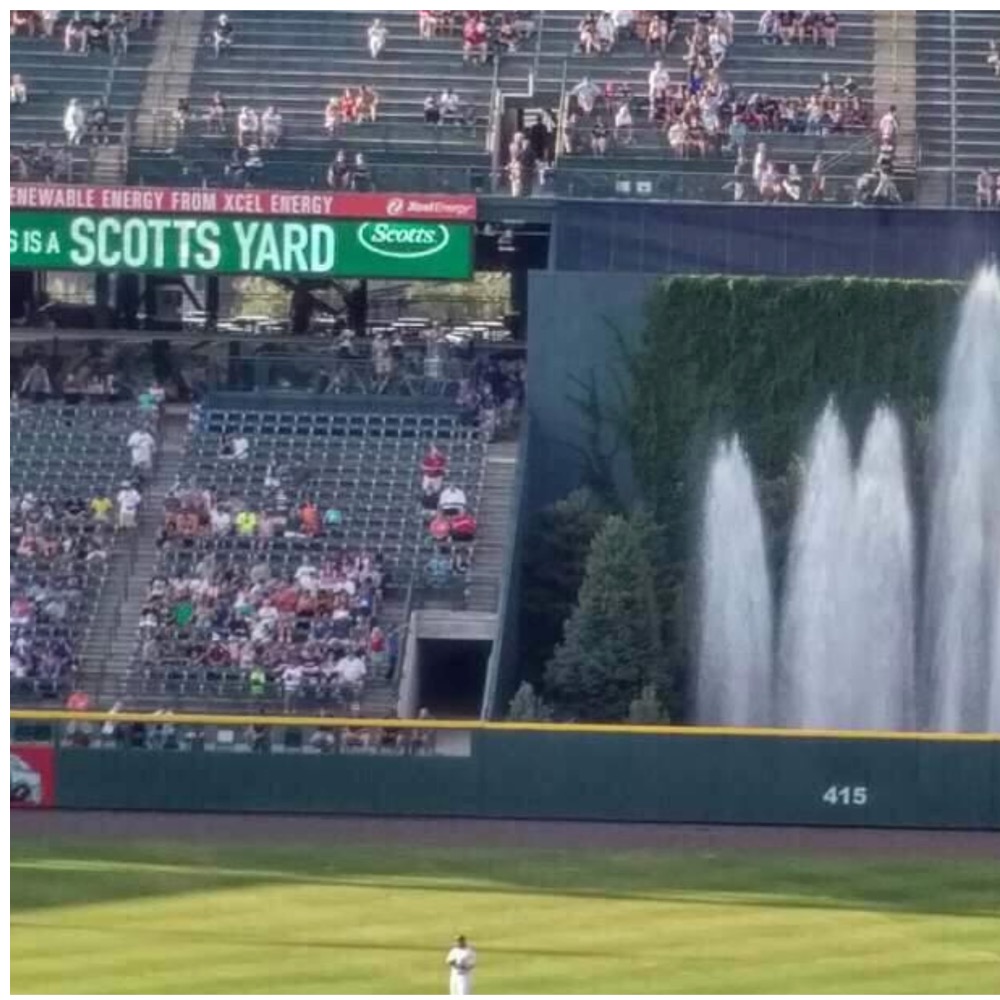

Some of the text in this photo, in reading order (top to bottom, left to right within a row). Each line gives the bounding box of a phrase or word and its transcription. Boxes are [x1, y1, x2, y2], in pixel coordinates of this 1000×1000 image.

[10, 186, 334, 215] ENEWABLE ENERGY FROM XCEL ENERGY
[23, 230, 42, 254] IS
[46, 231, 61, 254] A
[70, 216, 221, 270] SCOTTS
[232, 220, 335, 272] YARD
[370, 222, 438, 244] Scotts
[822, 785, 868, 805] 415
